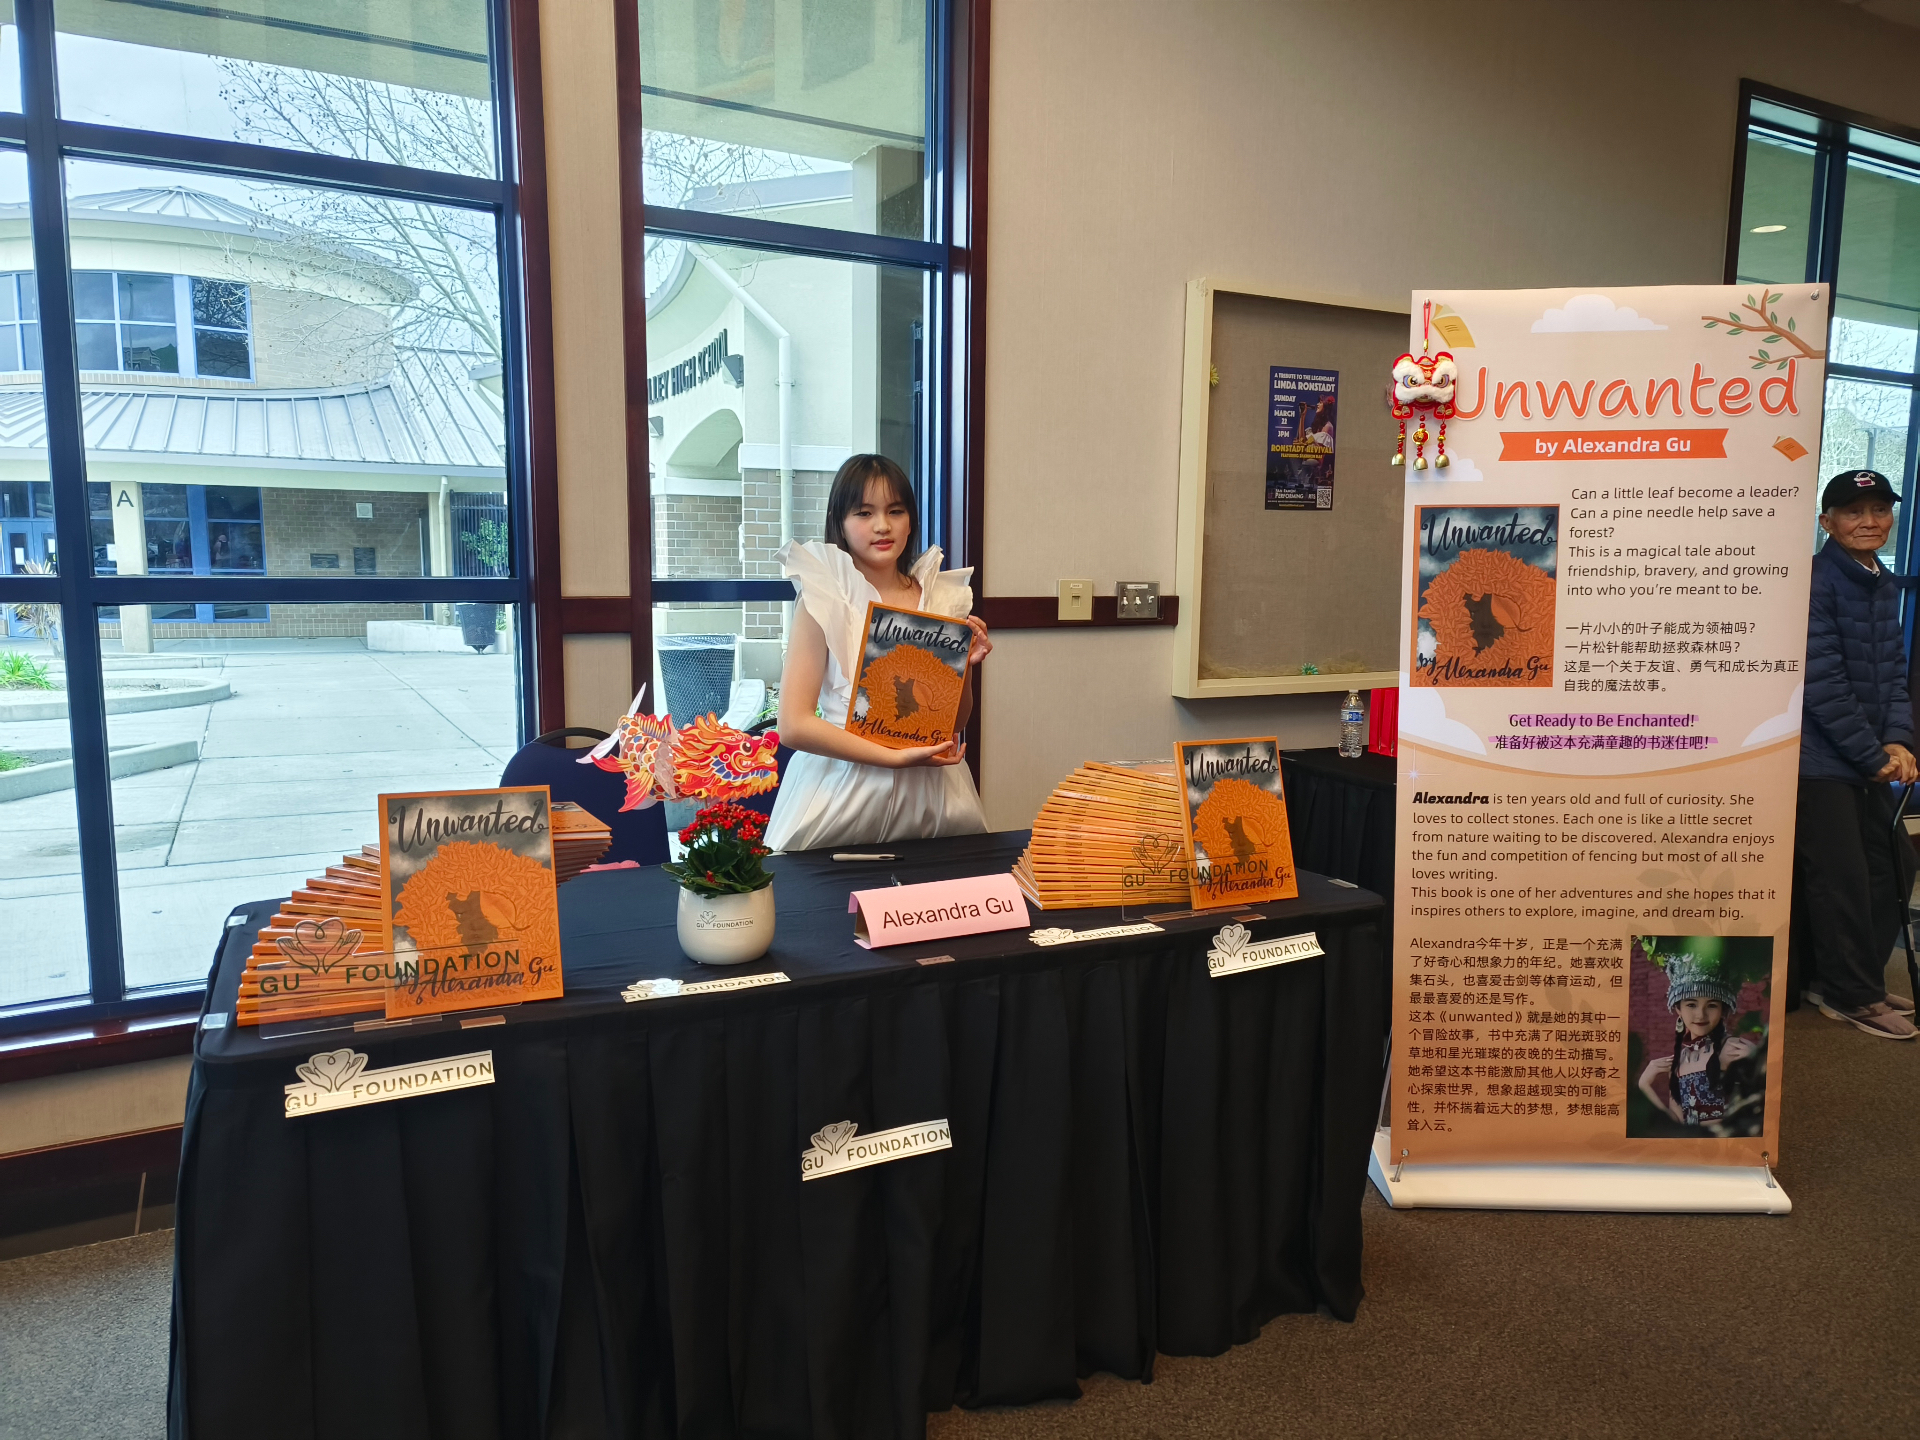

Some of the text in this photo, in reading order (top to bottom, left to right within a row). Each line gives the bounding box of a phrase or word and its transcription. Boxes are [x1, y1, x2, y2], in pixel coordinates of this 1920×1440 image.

[648, 370, 669, 404] LLEY
[671, 355, 697, 396] HIGH
[1274, 380, 1335, 392] LINDA RONSTADT
[1456, 358, 1799, 420] Unwanted
[1271, 444, 1333, 454] RONSTADT REVIVAL
[1535, 437, 1691, 457] by Alexandra Gu
[116, 489, 134, 507] A
[1572, 486, 1799, 499] Can a little leaf become a leader?
[1571, 506, 1775, 521] Can a pine needle help save a
[1421, 513, 1557, 556] Unwanted
[1570, 527, 1614, 538] forest?
[1569, 545, 1756, 559] This is a magical tale about
[1568, 564, 1788, 579] friendship, bravery, and growing
[1568, 583, 1761, 598] into who you're meant to be.
[871, 613, 969, 653] Unwanted
[1416, 653, 1550, 685] by Alexandra Gu
[1565, 679, 1667, 691] 自我的魔法故事。
[851, 711, 867, 729] by
[861, 718, 928, 743] Alexandra
[1510, 714, 1694, 730] Get Ready to Be Enchanted!
[1185, 747, 1279, 787] Unwanted
[1412, 792, 1754, 807] Alexandra is ten years old and full of curiosity. She
[389, 798, 549, 853] Unwanted
[1414, 813, 1446, 823] loves
[1450, 814, 1463, 823] to
[1468, 813, 1509, 824] collect
[1513, 814, 1558, 824] stones.
[1564, 813, 1594, 824] Each
[1598, 816, 1622, 824] one
[1628, 814, 1636, 824] is
[1642, 814, 1663, 824] like
[1680, 814, 1708, 825] little
[1713, 815, 1752, 825] secret
[1412, 831, 1774, 846] from nature waiting to be discovered. Alexandra enjoys
[1412, 850, 1764, 864] the fun and competition of fencing but most of all she
[1124, 859, 1268, 887] GU FOUNDATION
[1275, 867, 1292, 884] Gu
[883, 898, 1014, 929] Alexandra Gu
[1412, 905, 1744, 920] inspires others to explore, imagine, and dream big.
[713, 920, 754, 928] FOUNDATION
[1208, 941, 1320, 969] GU FOUNDATION
[260, 950, 519, 993] GU FOUNDATION
[528, 957, 557, 985] Gu
[678, 975, 788, 993] OUNDATION
[1410, 992, 1535, 1005] 最最喜爱的还是写作。
[286, 1061, 492, 1111] GU FOUNDATION
[1407, 1118, 1453, 1132] 耸入云。
[803, 1128, 950, 1171] GU FOUNDATION
